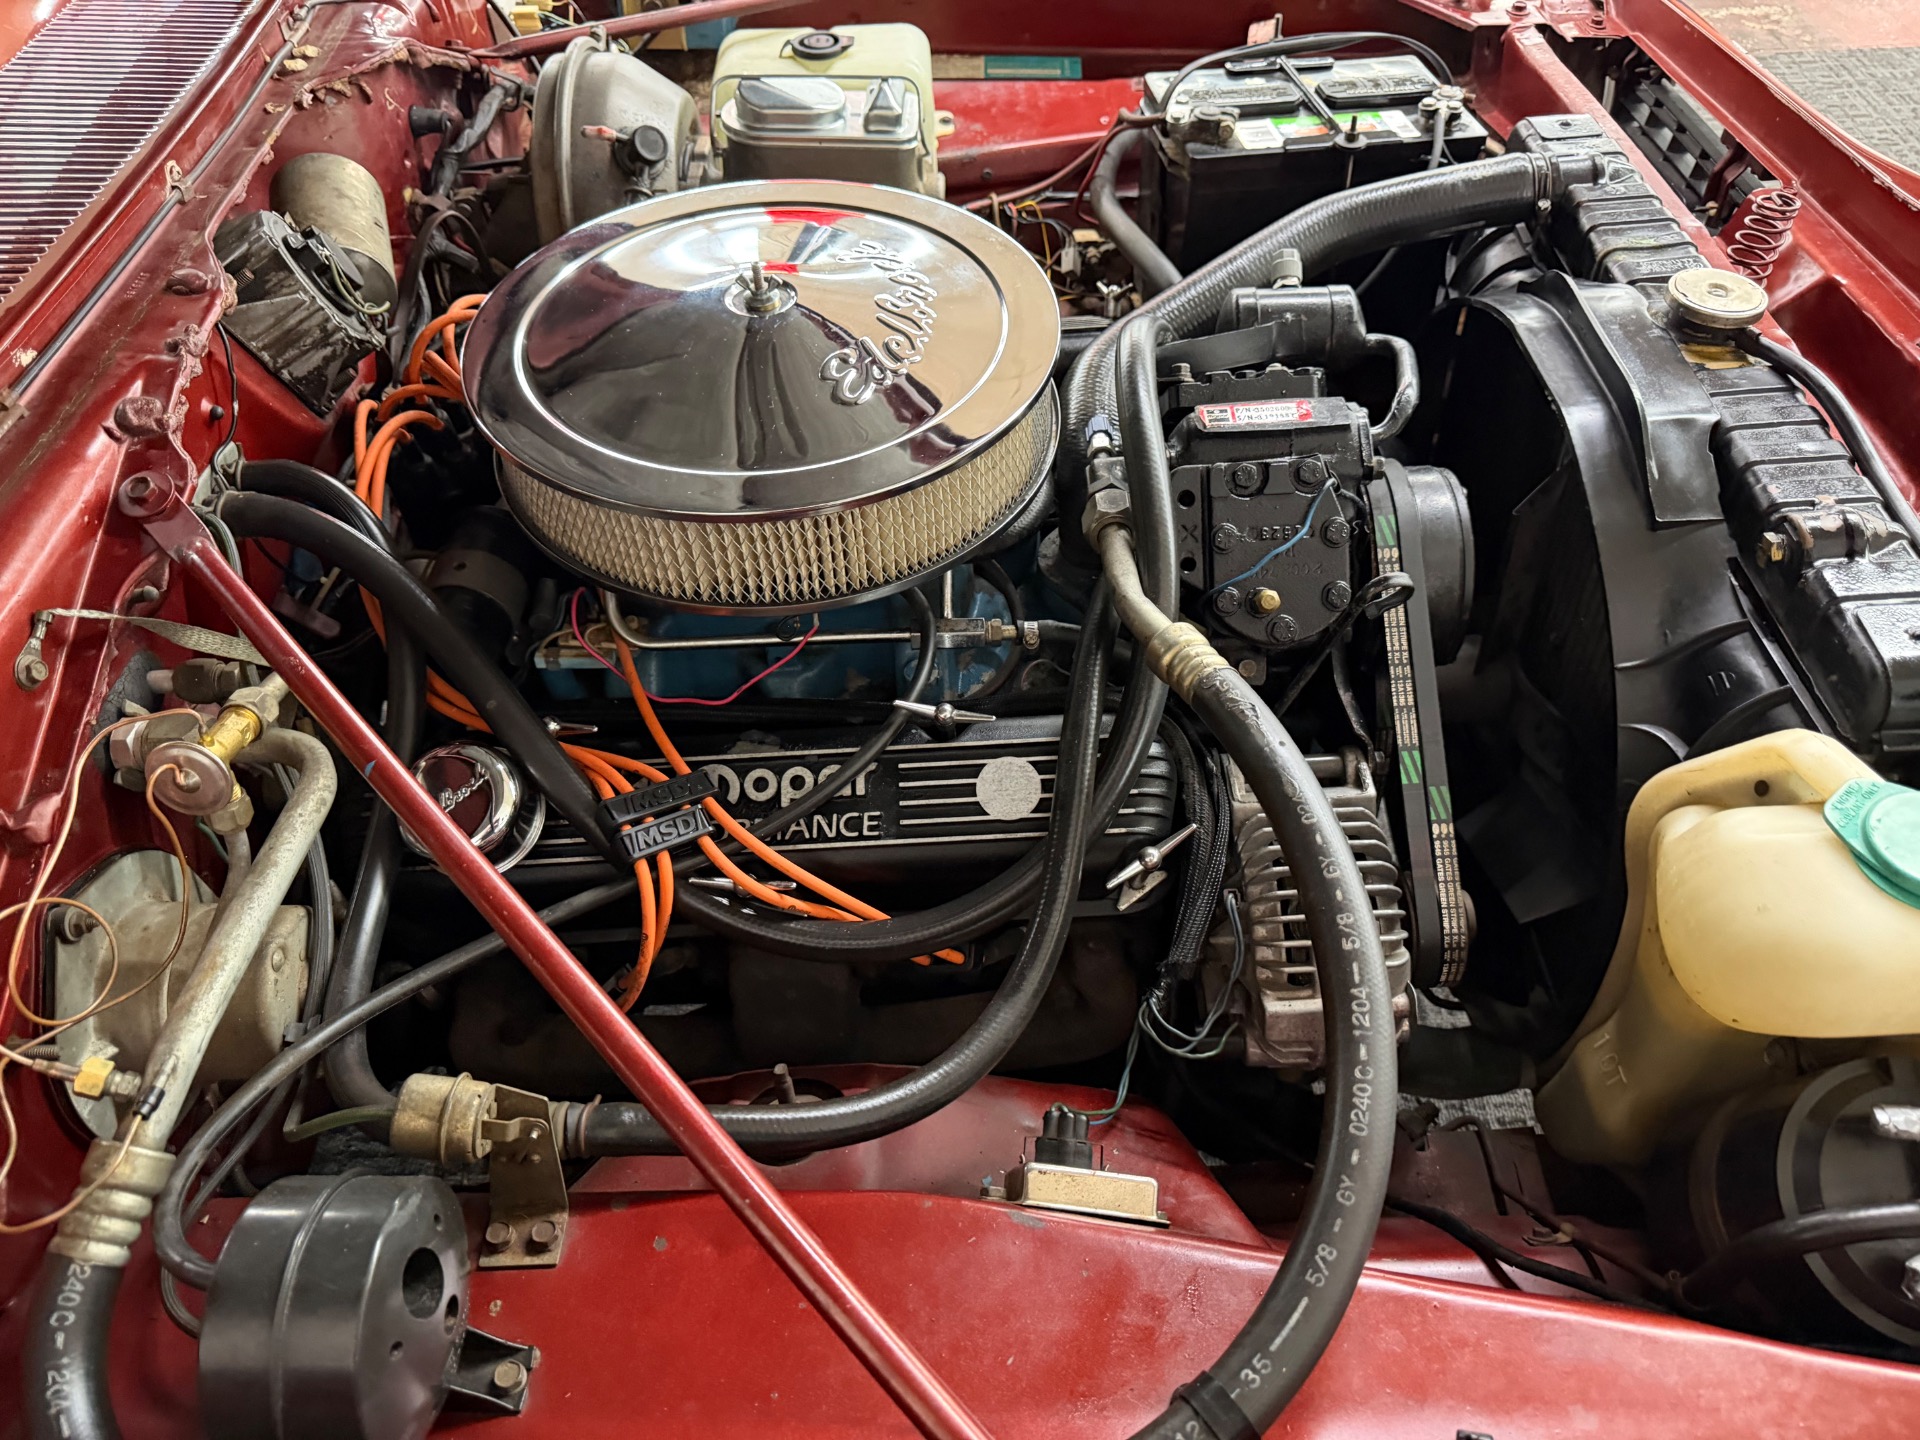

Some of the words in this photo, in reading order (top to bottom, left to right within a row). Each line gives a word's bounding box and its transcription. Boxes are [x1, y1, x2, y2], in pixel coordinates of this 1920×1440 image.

[636, 815, 696, 850] MSD
[1318, 855, 1341, 879] GY
[1436, 858, 1445, 882] GATES
[1336, 912, 1361, 951] 5/8
[1336, 1174, 1356, 1207] GY
[1305, 1243, 1337, 1288] 5/8
[49, 1262, 92, 1327] 240C
[1240, 1352, 1272, 1389] 35
